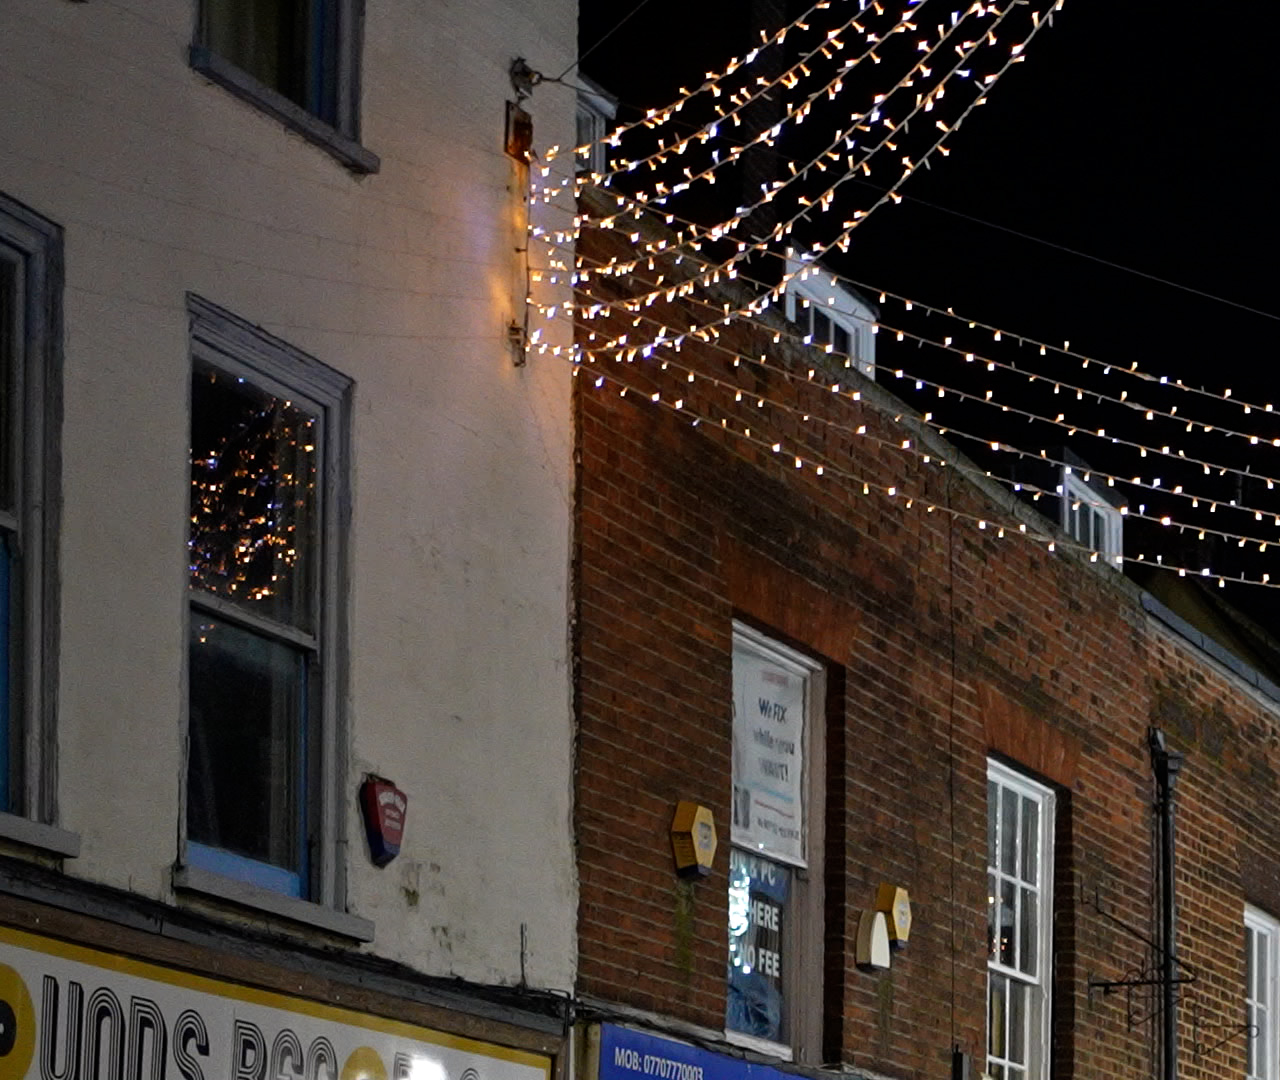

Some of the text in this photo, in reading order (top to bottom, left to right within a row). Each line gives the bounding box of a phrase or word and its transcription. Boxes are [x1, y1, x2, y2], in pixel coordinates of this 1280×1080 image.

[750, 899, 780, 932] HERE
[758, 950, 780, 977] FEE
[614, 1046, 642, 1072] MOB:
